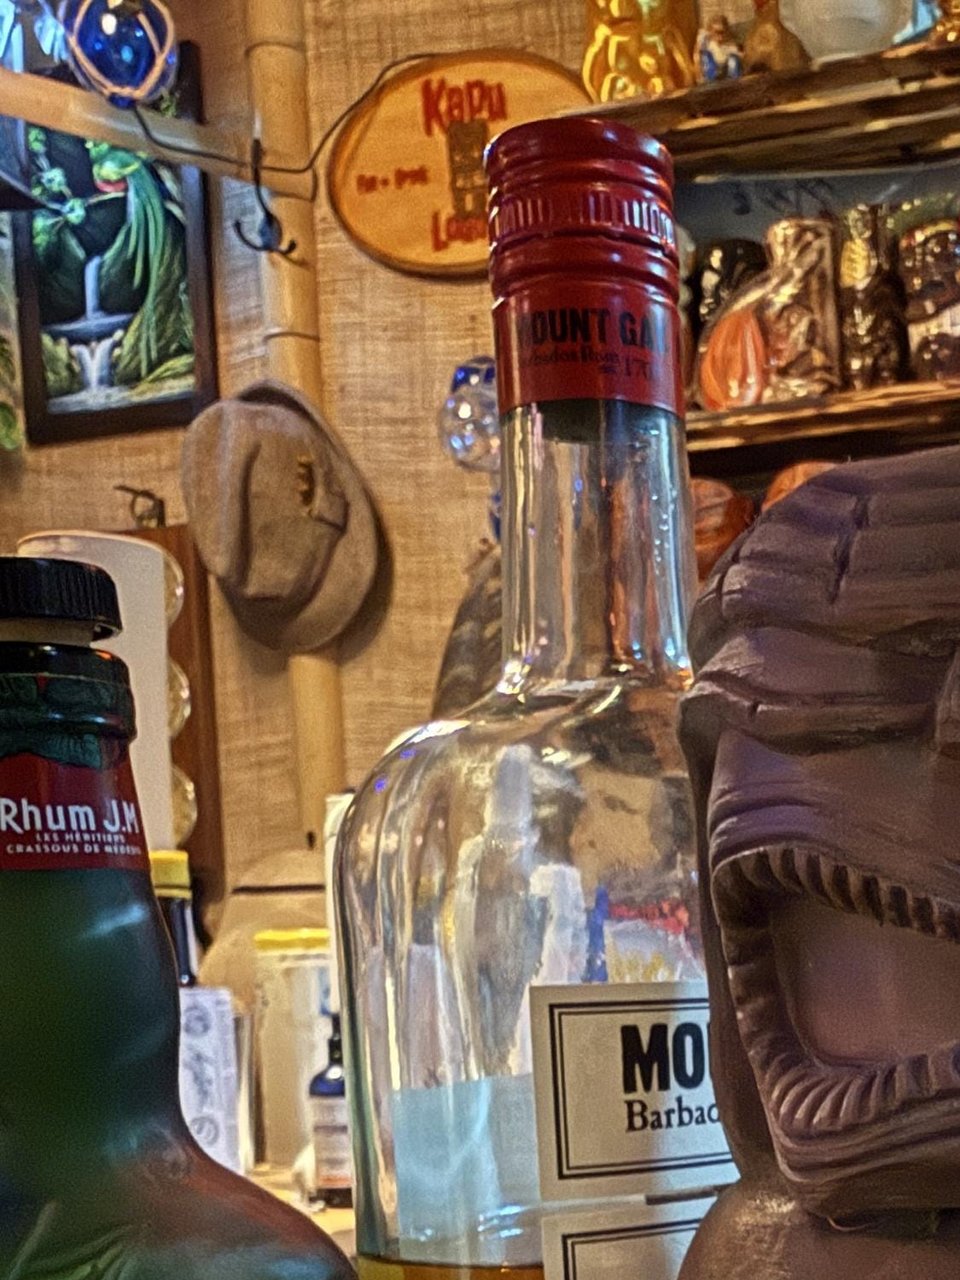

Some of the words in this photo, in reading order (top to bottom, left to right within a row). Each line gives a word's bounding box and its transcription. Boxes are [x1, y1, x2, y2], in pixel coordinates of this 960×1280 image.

[0, 797, 97, 834] Rhum
[103, 798, 139, 833] J.M
[6, 843, 80, 854] CRASSOUS
[84, 843, 101, 854] DE
[620, 1021, 711, 1095] MO
